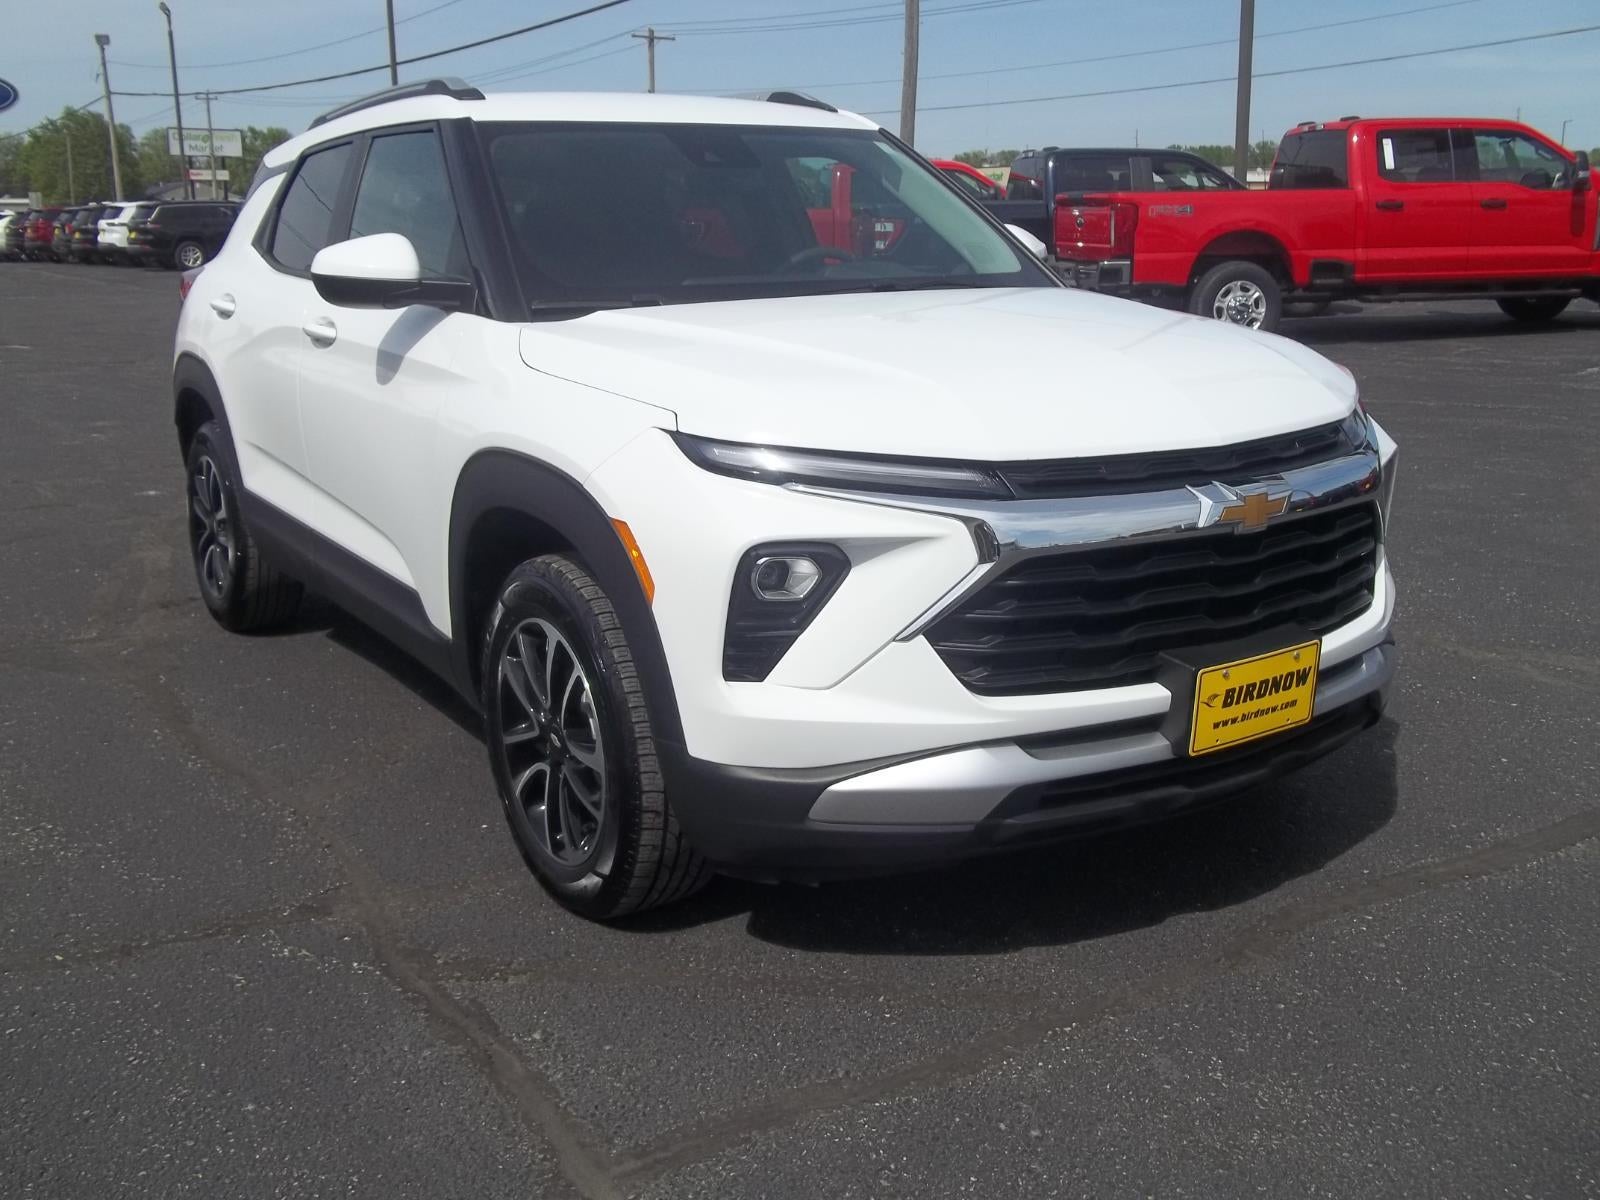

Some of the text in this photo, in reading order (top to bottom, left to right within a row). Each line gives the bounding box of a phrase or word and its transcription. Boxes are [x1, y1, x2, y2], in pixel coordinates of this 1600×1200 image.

[188, 143, 224, 153] Maret
[1221, 665, 1312, 709] BIRDNOW
[1212, 699, 1298, 730] www.birdnow.com
